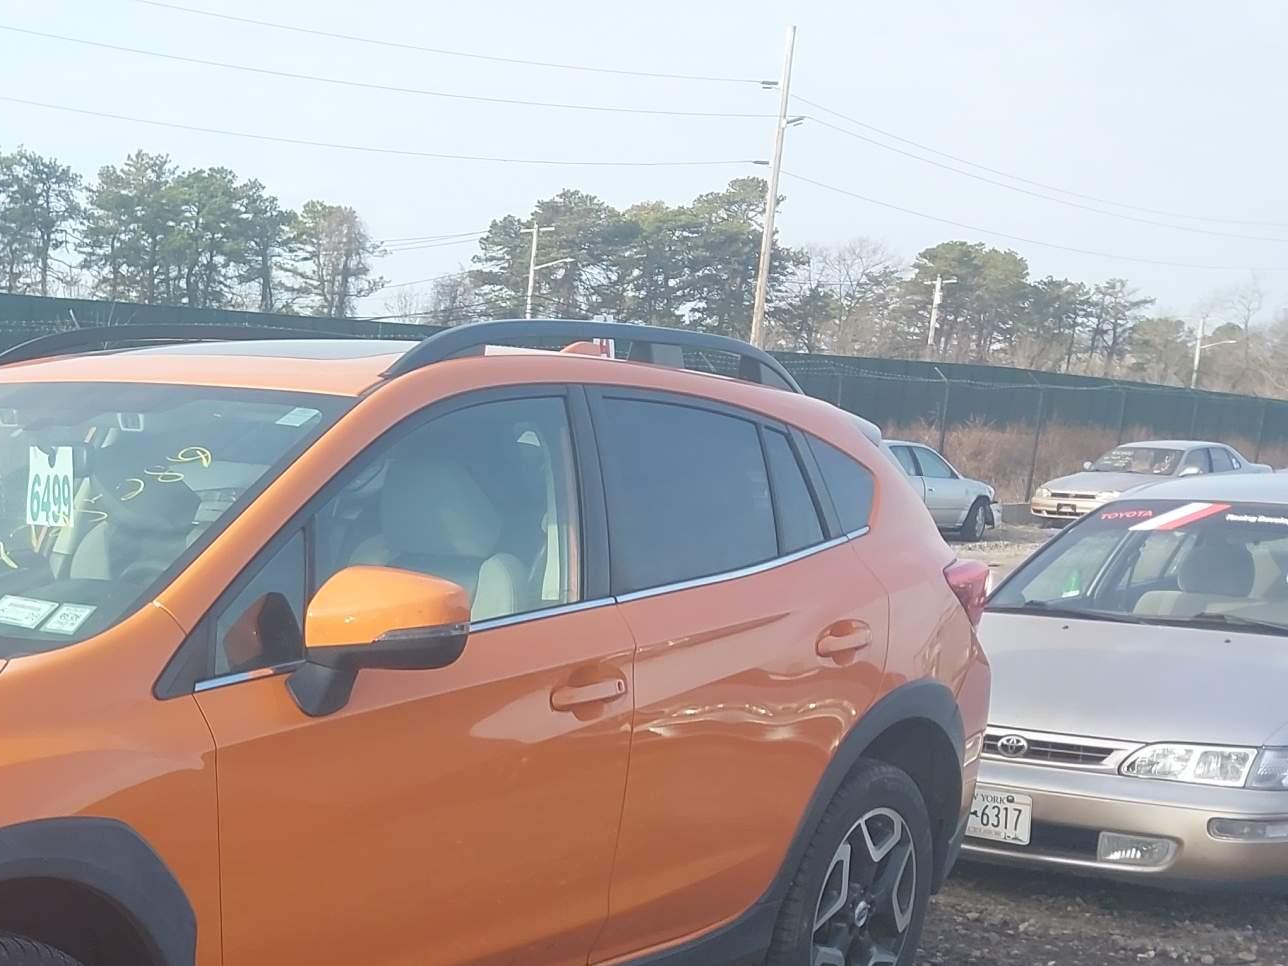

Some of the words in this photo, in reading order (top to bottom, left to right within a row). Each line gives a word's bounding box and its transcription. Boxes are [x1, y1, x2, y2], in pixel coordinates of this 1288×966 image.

[30, 473, 71, 523] 6499
[1101, 510, 1153, 520] TOYOTA
[980, 794, 1006, 804] YORK
[980, 804, 1022, 831] 6317
